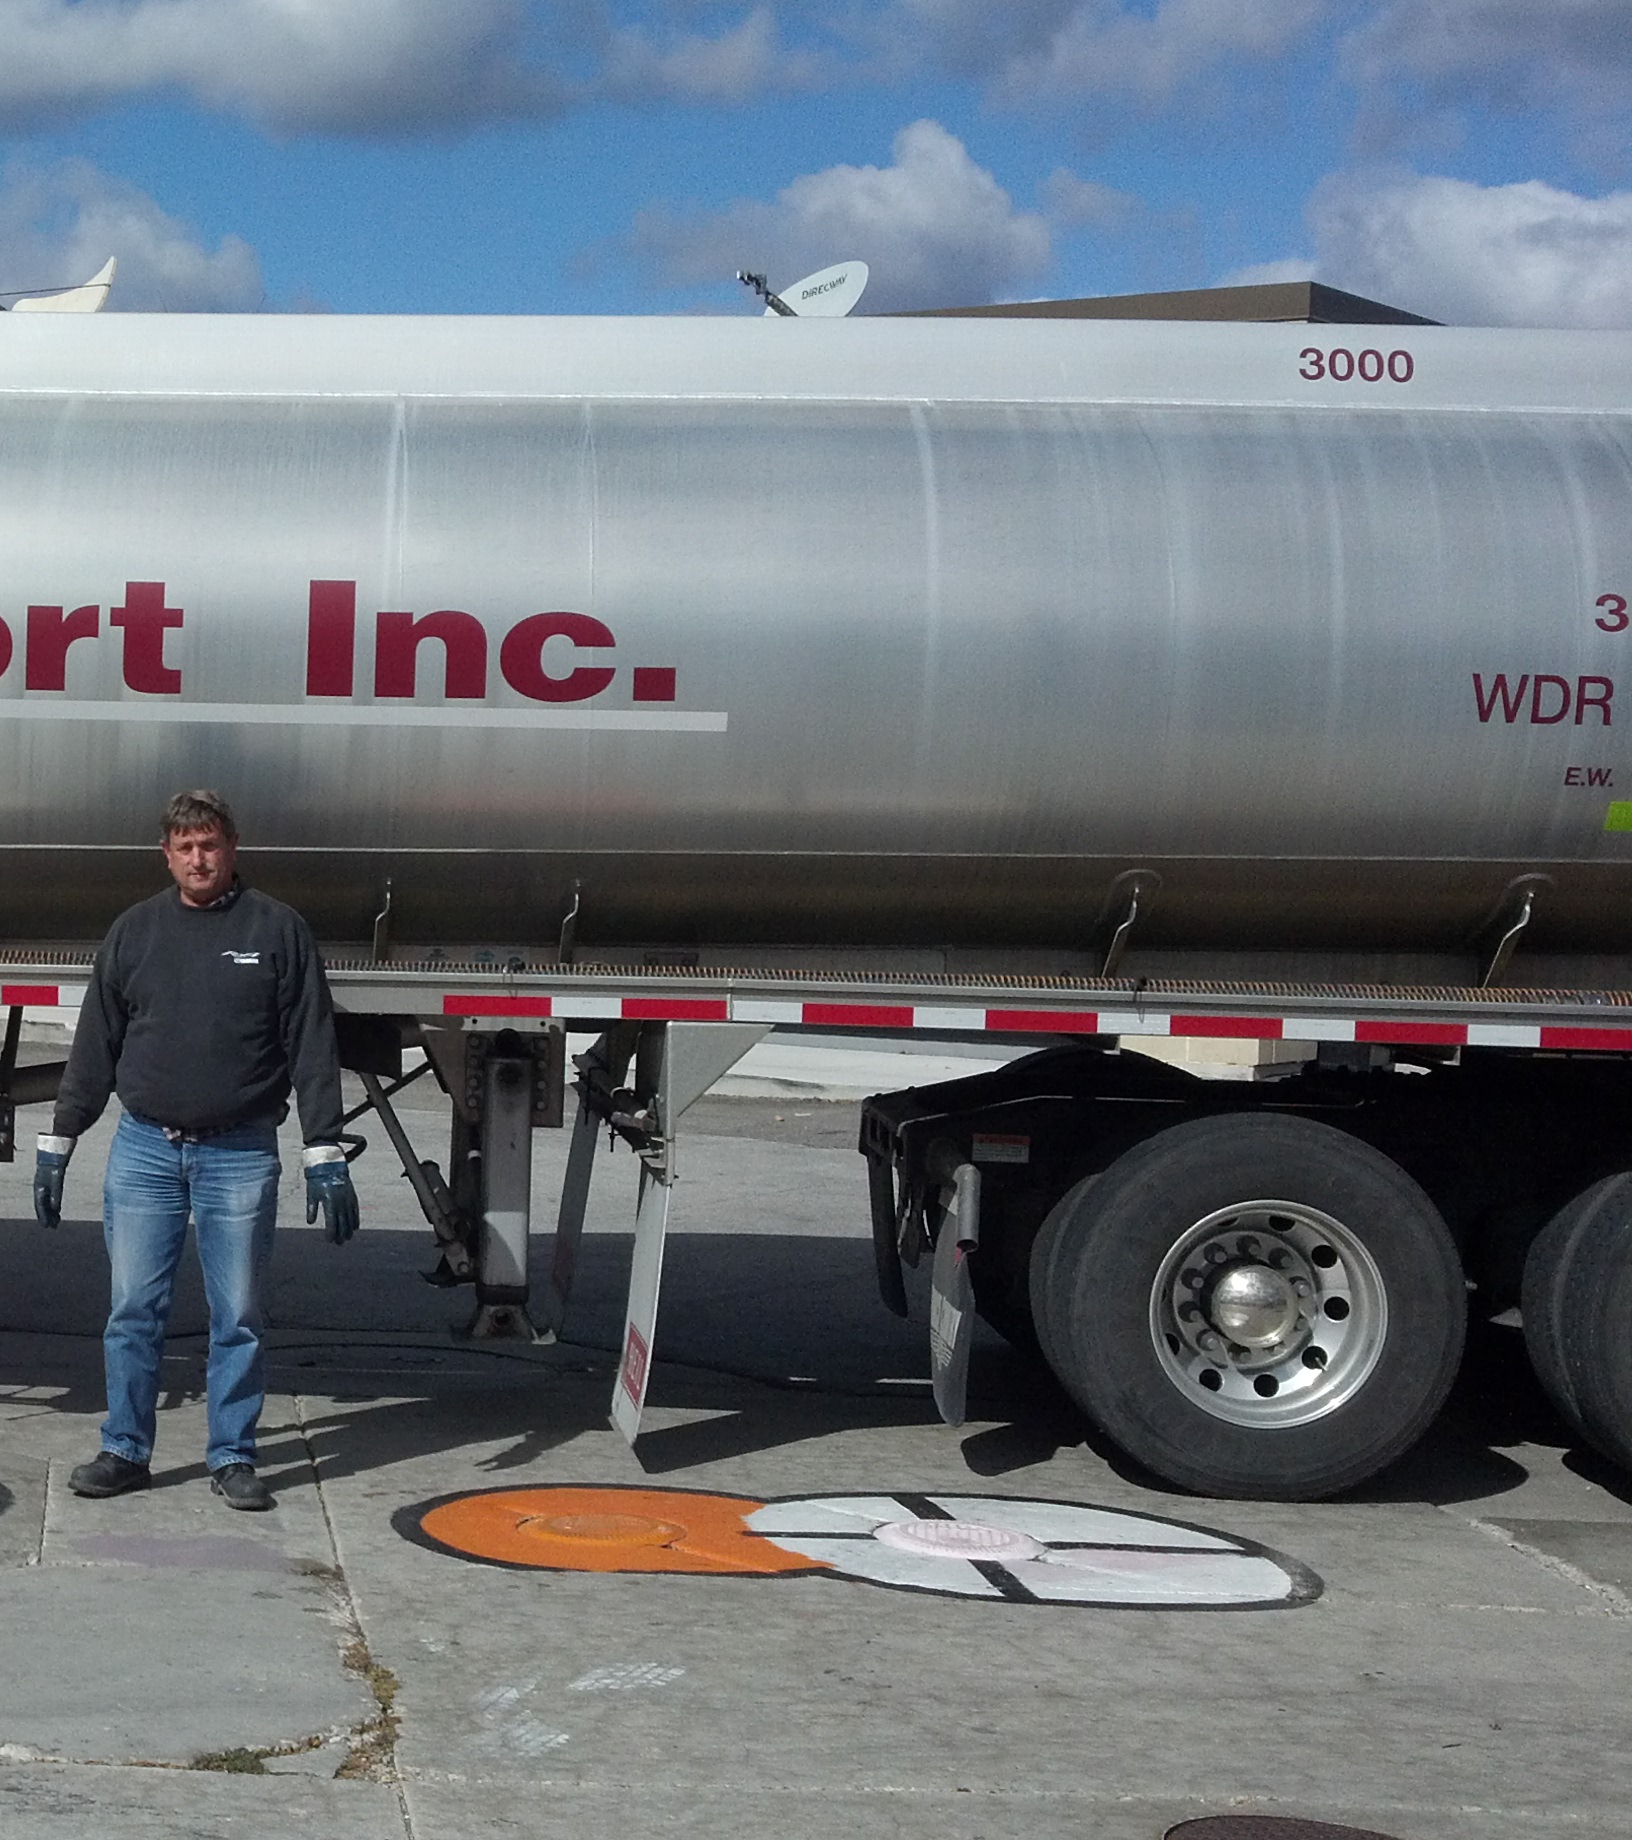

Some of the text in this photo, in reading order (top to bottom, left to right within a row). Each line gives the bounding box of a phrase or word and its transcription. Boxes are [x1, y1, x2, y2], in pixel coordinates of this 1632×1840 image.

[1298, 347, 1415, 383] 3000
[305, 579, 676, 703] Inc.
[1472, 673, 1614, 726] WDR
[1564, 766, 1614, 787] E.W.
